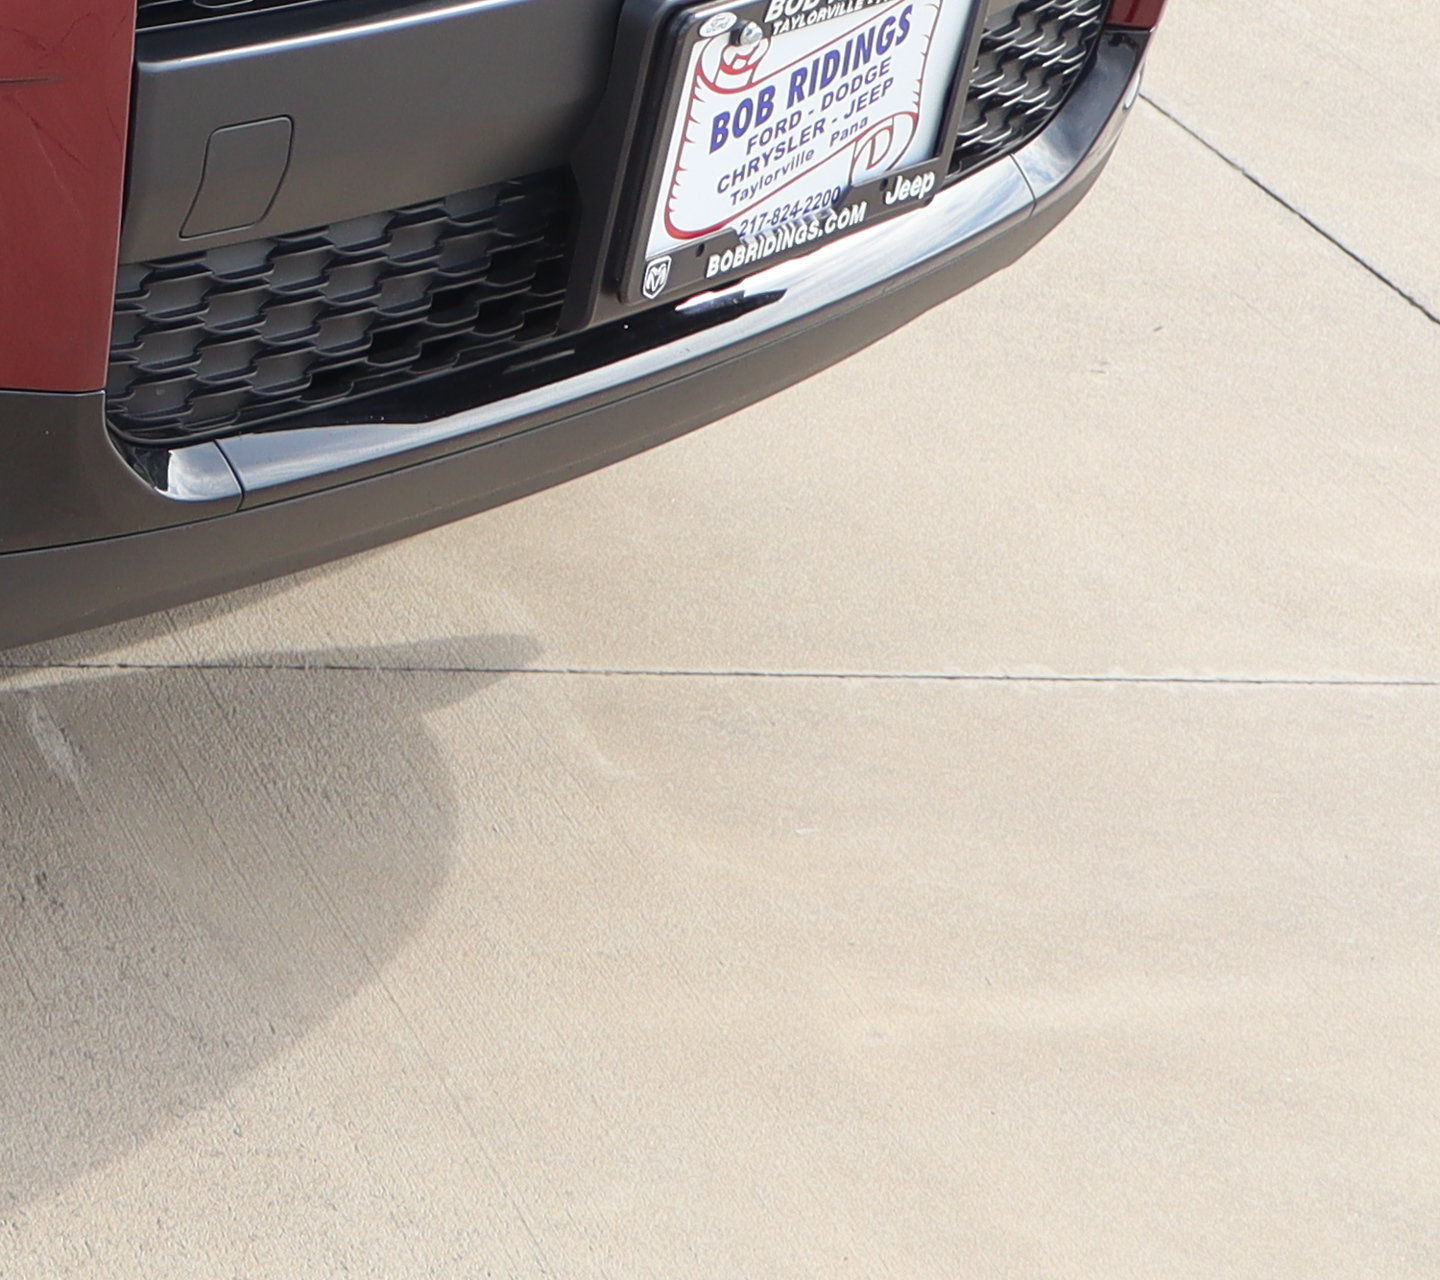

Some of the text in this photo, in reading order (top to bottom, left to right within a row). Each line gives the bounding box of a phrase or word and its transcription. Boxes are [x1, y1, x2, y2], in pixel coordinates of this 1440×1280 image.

[709, 4, 913, 154] BOB RIDINGS
[746, 109, 802, 156] FORD
[820, 57, 892, 112] DODGE
[716, 118, 826, 194] CHRYSLER
[844, 77, 894, 120] JEEP
[730, 116, 869, 206] Taylorville Pana
[739, 186, 842, 238] 217-824-2200
[884, 171, 935, 205] Jeep
[706, 201, 867, 278] BOBRIDINGS.COM
